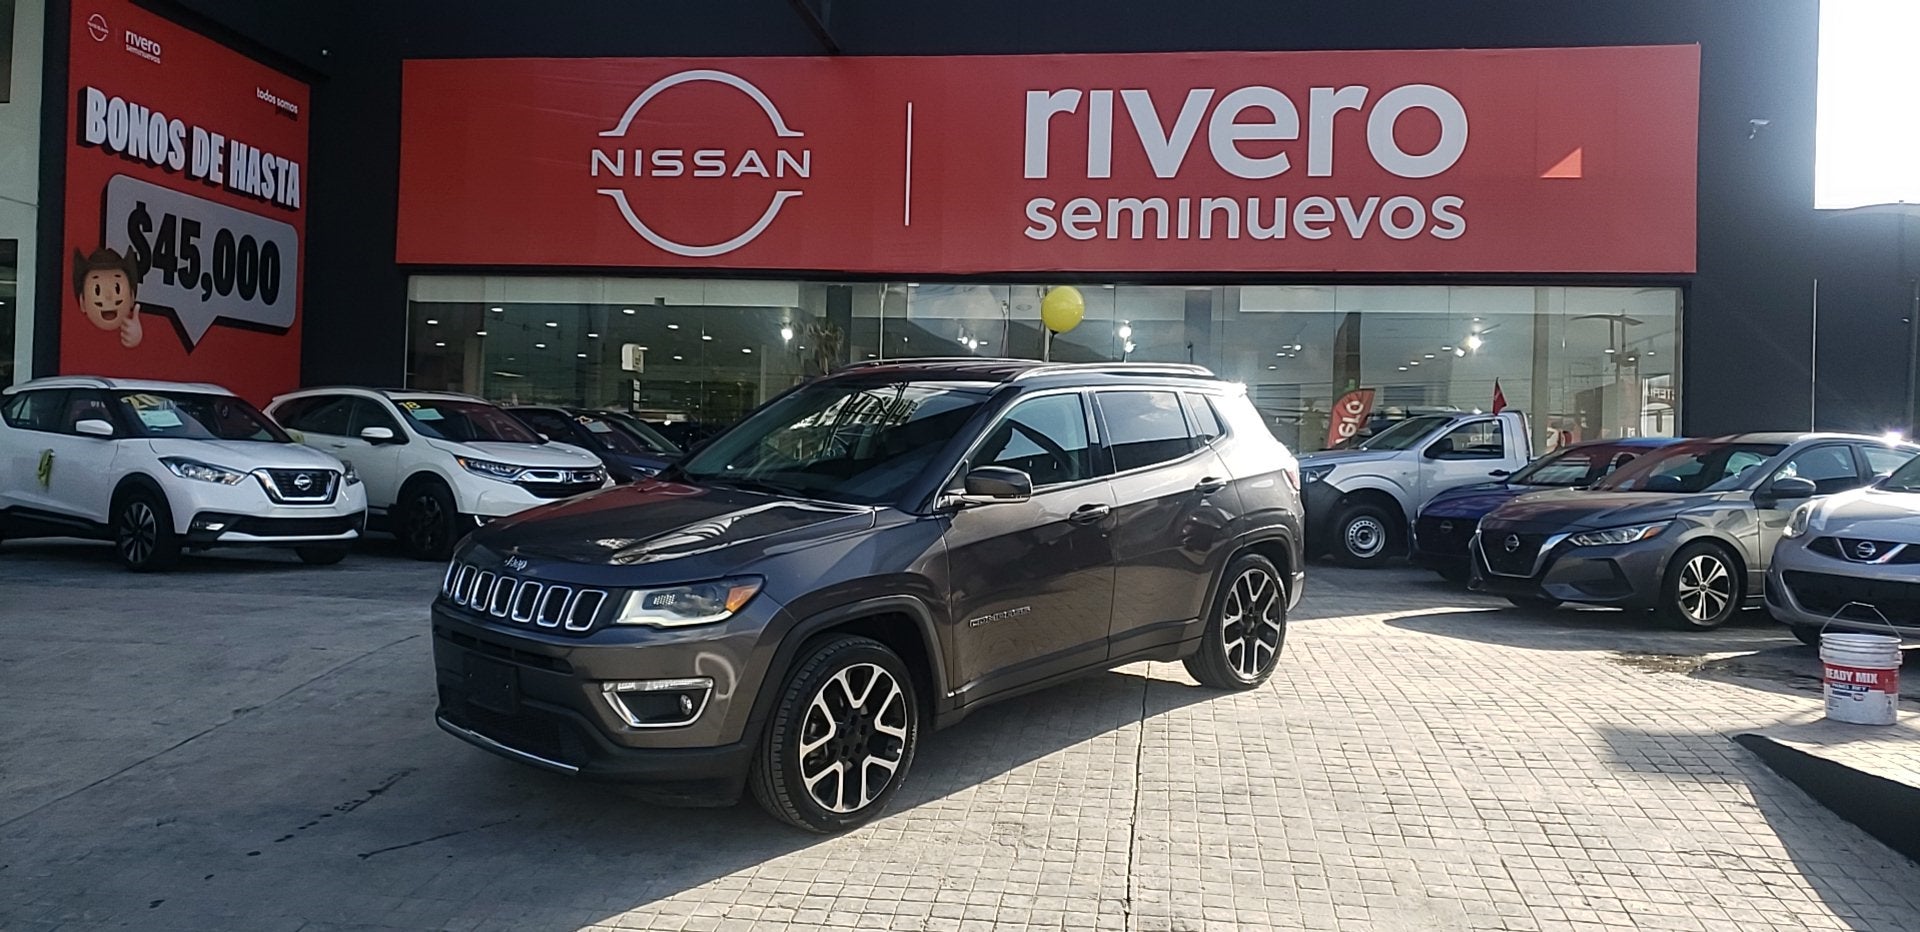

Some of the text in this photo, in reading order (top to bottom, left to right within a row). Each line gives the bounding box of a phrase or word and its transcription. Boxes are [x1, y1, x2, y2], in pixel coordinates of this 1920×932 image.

[125, 30, 160, 56] rivero
[256, 86, 276, 105] todos
[277, 97, 298, 114] somos
[86, 86, 300, 209] BONOS DE HASTA
[1023, 84, 1469, 179] rivero
[591, 149, 811, 178] NISSAN
[1023, 195, 1467, 241] seminuevos
[127, 200, 281, 306] $45,000
[1334, 400, 1365, 444] ero
[1856, 672, 1878, 684] MIX
